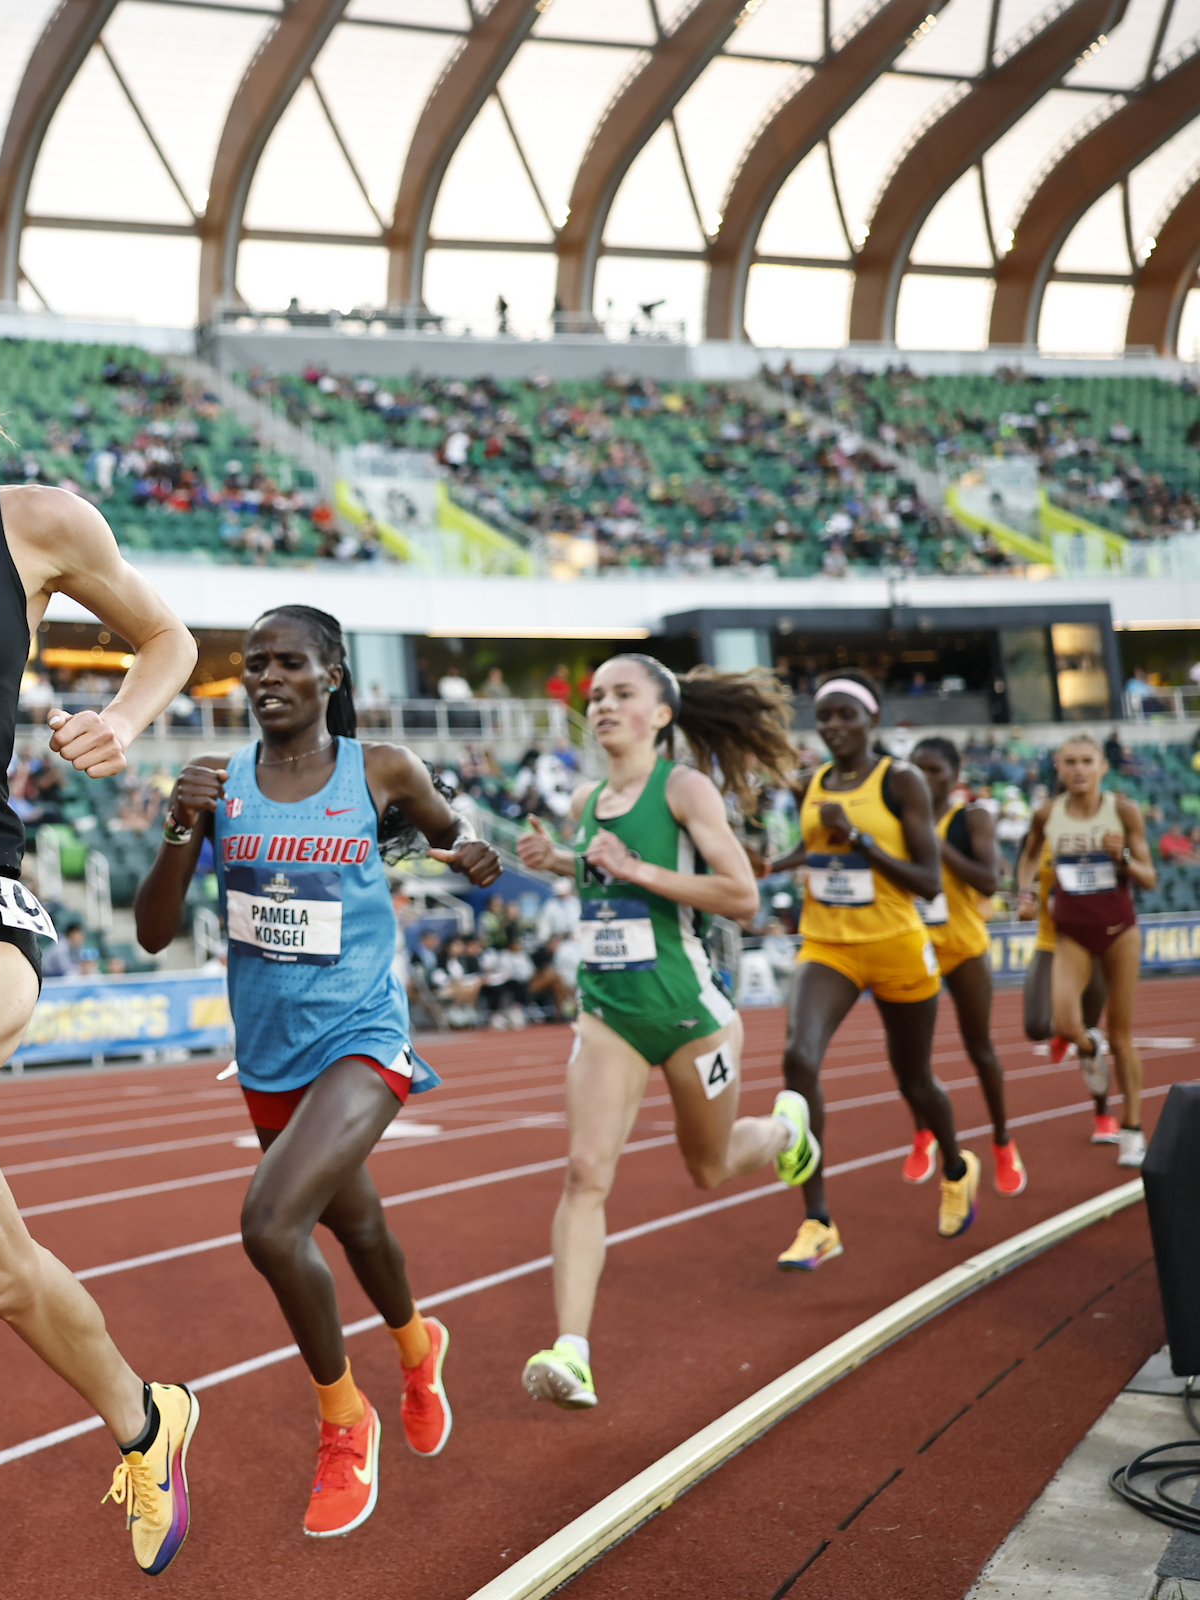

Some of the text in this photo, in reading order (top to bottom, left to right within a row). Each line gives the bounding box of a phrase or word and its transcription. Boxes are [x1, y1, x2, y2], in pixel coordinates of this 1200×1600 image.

[266, 834, 372, 866] MEXICO
[251, 903, 310, 927] PAMELA
[254, 925, 305, 948] KOSGEI
[708, 1053, 728, 1087] 4
